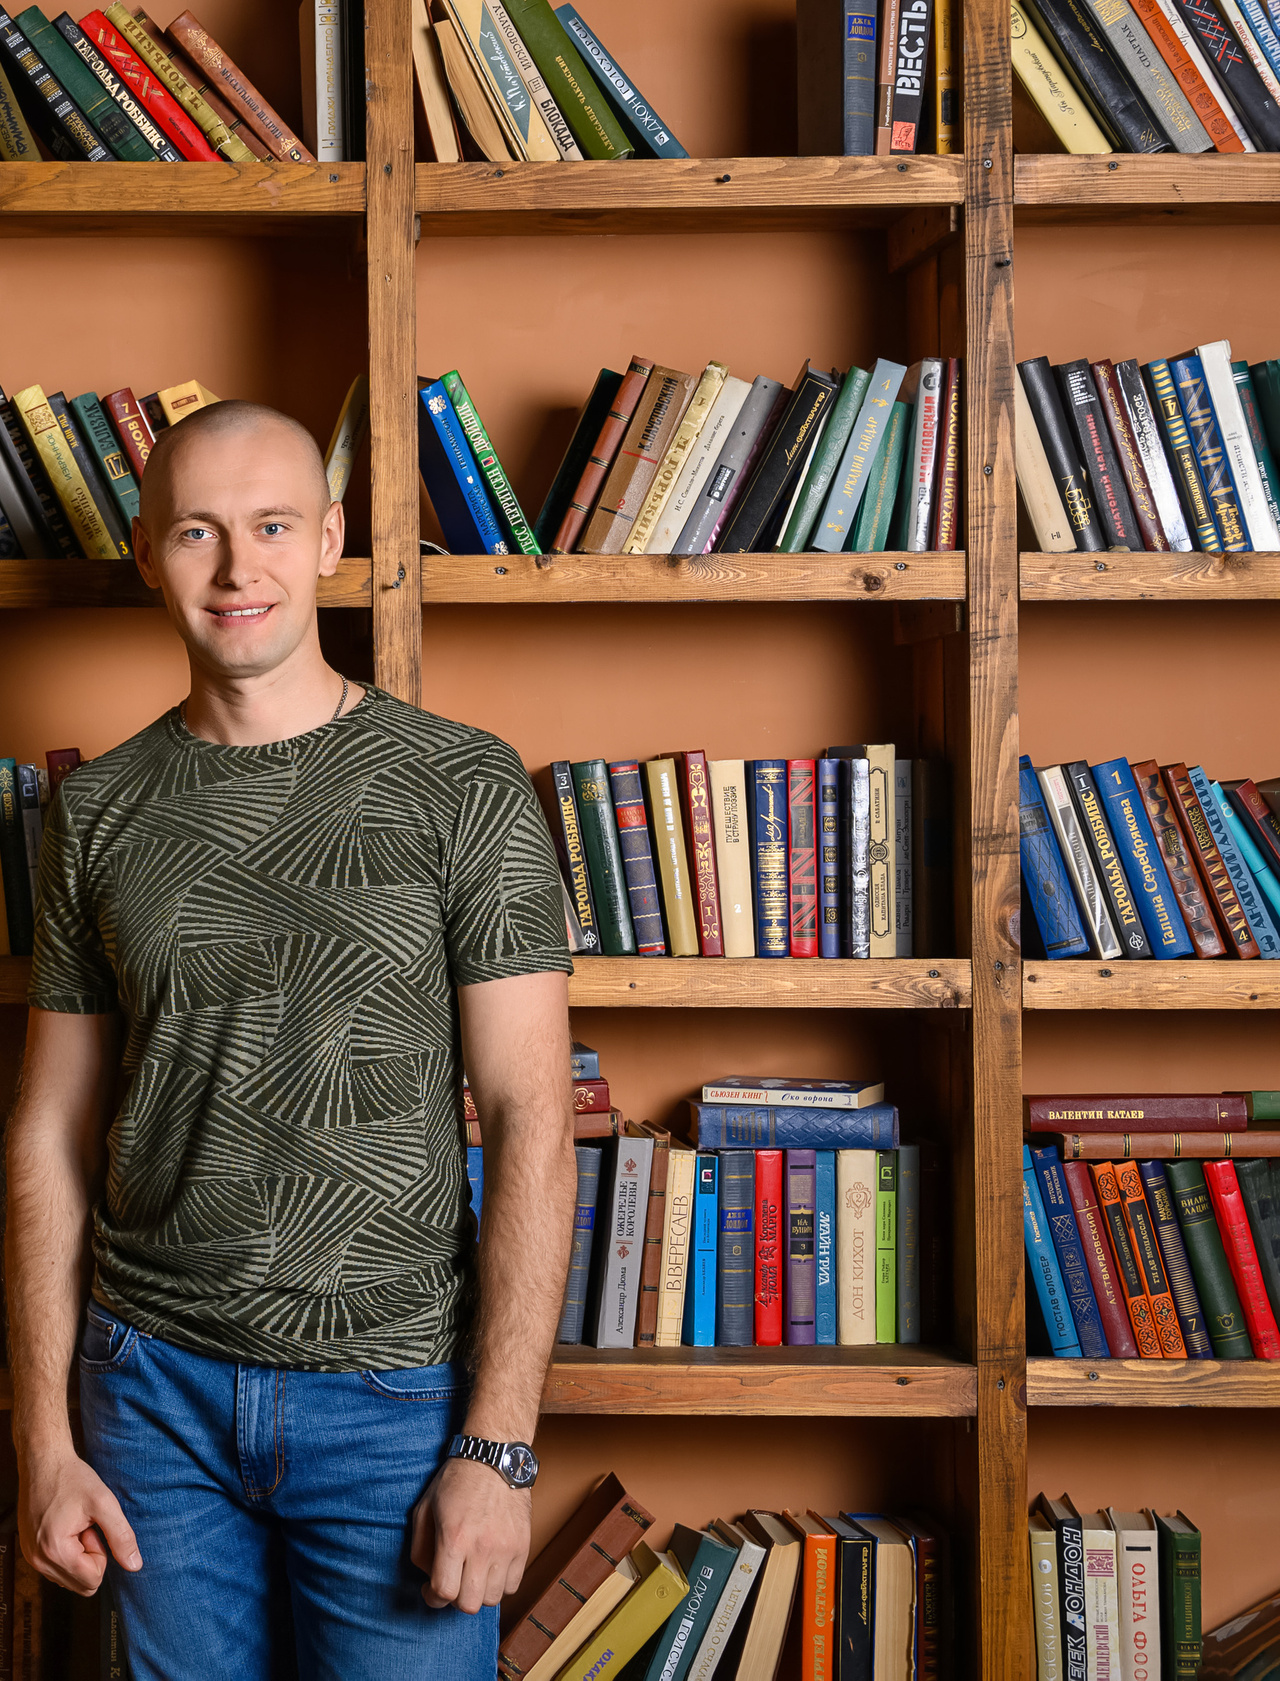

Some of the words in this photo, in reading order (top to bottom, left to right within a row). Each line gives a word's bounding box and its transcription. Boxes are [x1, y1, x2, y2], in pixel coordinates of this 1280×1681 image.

[569, 19, 631, 94] ГОЛСУОРСИ
[895, 0, 926, 95] ВЕСТЬ
[1119, 23, 1151, 69] СПАРТАК
[553, 54, 587, 104] ЧАКОВСКИЙ
[115, 89, 166, 150] РОББИНС
[540, 97, 575, 150] БЛОКАДА
[581, 103, 615, 152] АЛЕКСАНДР
[626, 95, 662, 134] ДЖОН
[82, 400, 115, 451] БАЛЬЗАК
[454, 401, 490, 455] ДВОЙНИК
[1085, 413, 1107, 471] КАЛИНИН
[45, 433, 72, 480] ИЗБРАННОЕ
[840, 453, 865, 498] АРКАДИЙ
[856, 415, 879, 452] ГАЙДАР
[486, 466, 523, 526] ГЕРРИТСЕН
[940, 476, 955, 544] МИХАИЛ
[1099, 474, 1126, 538] АНАТОЛИЙ
[513, 525, 536, 554] ТЕСС
[561, 795, 581, 860] РОББИНС
[722, 786, 731, 842] ПУТЕШЕСТВИЕ
[1080, 790, 1113, 859] РОББИНС
[1189, 772, 1230, 848] АЛЕКСИН
[1117, 797, 1159, 893] Серебрякова
[573, 863, 593, 926] ГАРОЛЬД
[1105, 858, 1136, 924] ГАРОЛЬД
[1221, 848, 1265, 931] АНАТОЛИЙ
[1150, 894, 1176, 944] Галина
[741, 1090, 762, 1099] КИНГ
[1048, 1110, 1103, 1119] ВАЛЕНТИН
[1107, 1110, 1144, 1119] КАТАЕВ
[616, 1180, 627, 1236] ОЖЕРЕЛЬЕ
[626, 1181, 636, 1236] КОРОЛЕВЫ
[760, 1199, 769, 1241] Королева
[817, 1211, 830, 1254] МАЙН
[617, 1266, 626, 1290] Дюма
[818, 1256, 829, 1284] РИД
[853, 1228, 864, 1279] КИХОТ
[1039, 1255, 1057, 1295] ФЛОБЕР
[616, 1292, 626, 1333] Александр
[853, 1286, 864, 1319] ДОН
[1049, 1298, 1066, 1337] ГЮСТАВ
[813, 1547, 828, 1627] ОСТРОВОЙ
[1063, 1526, 1084, 1630] ЛОНДОН
[1131, 1562, 1146, 1621] ОЛЬГА
